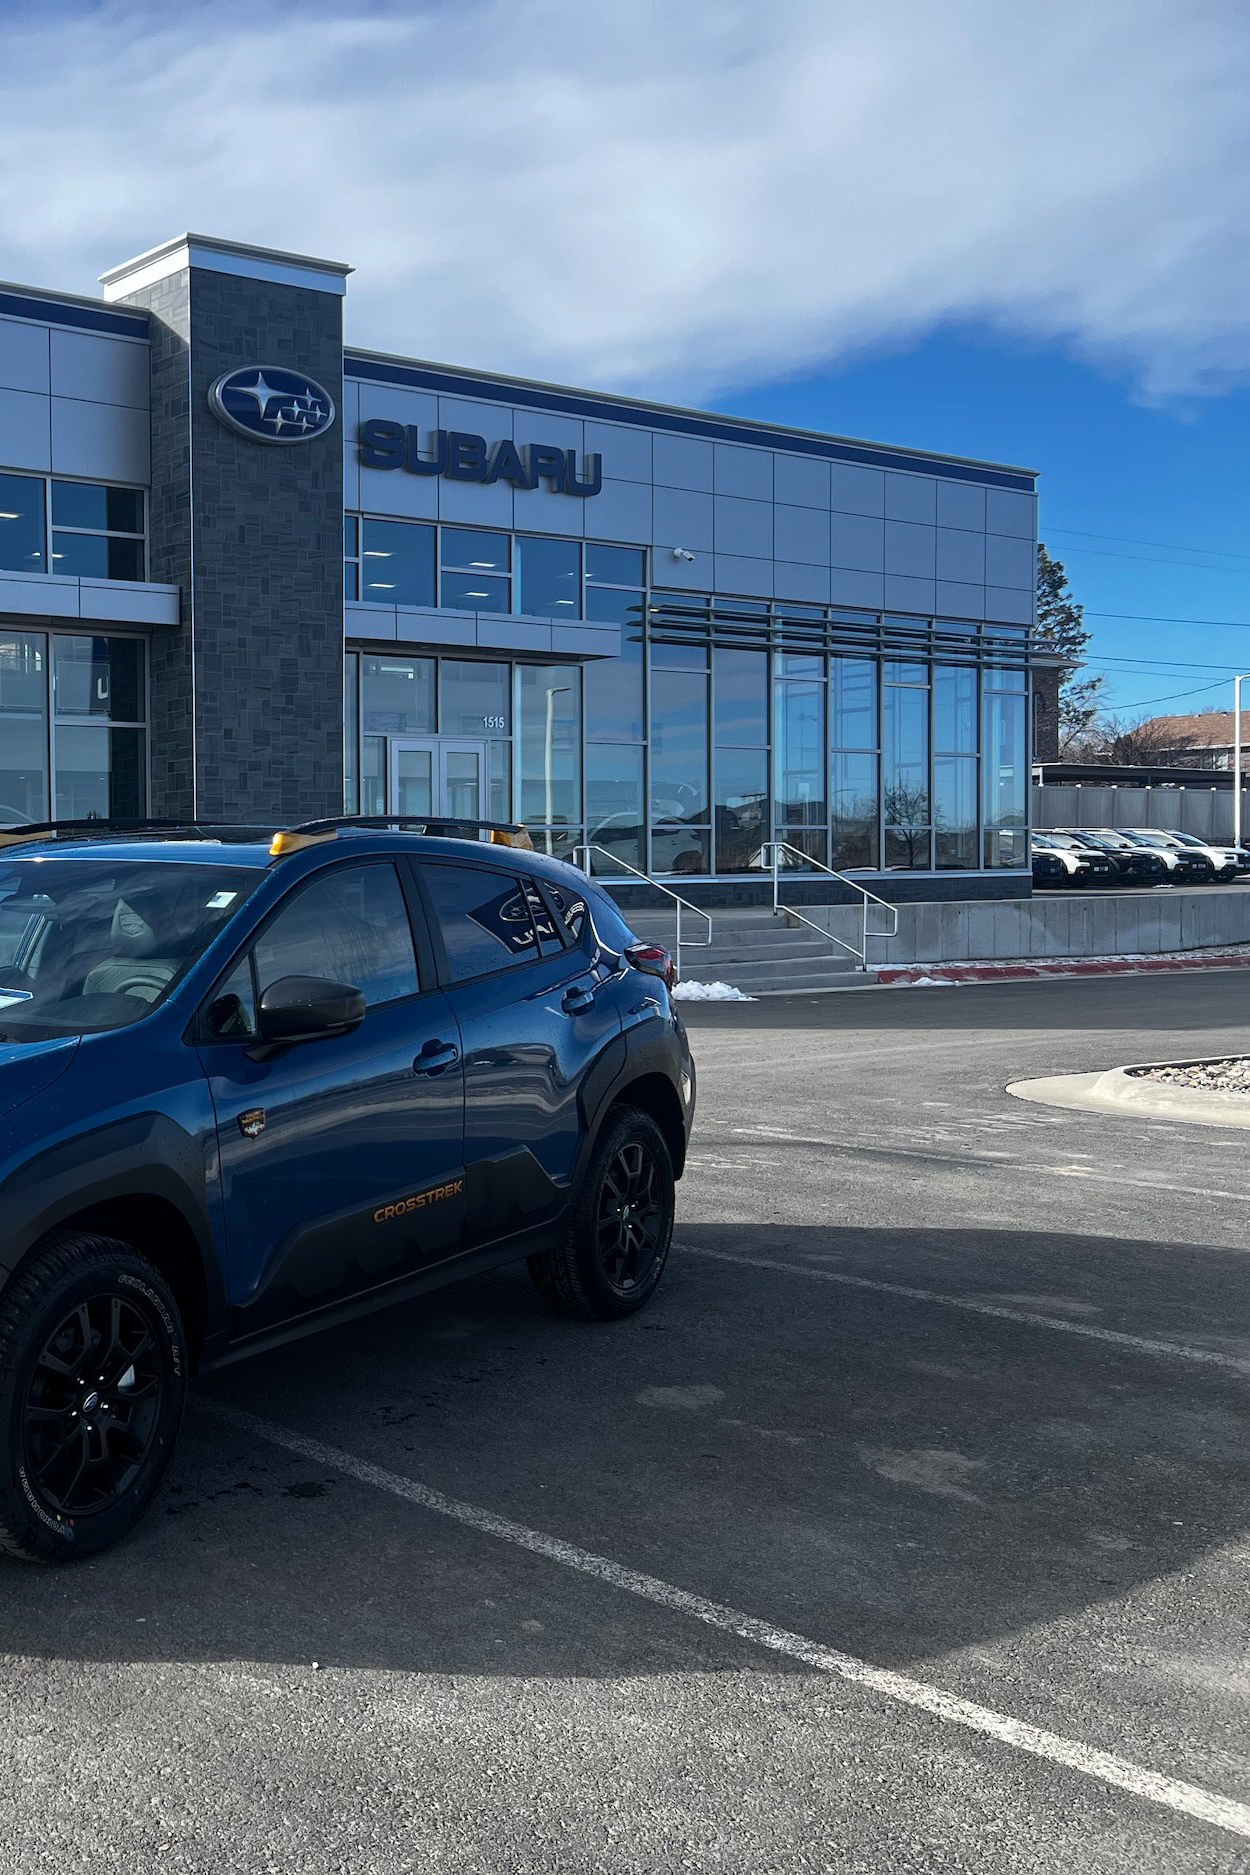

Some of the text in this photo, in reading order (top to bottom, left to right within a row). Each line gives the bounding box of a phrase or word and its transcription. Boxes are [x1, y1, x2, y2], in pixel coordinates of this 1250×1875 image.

[359, 418, 602, 497] SUBARU
[483, 716, 504, 728] 1515
[373, 1180, 463, 1224] CROSSTREK
[18, 1465, 66, 1535] YOKOHAMA
